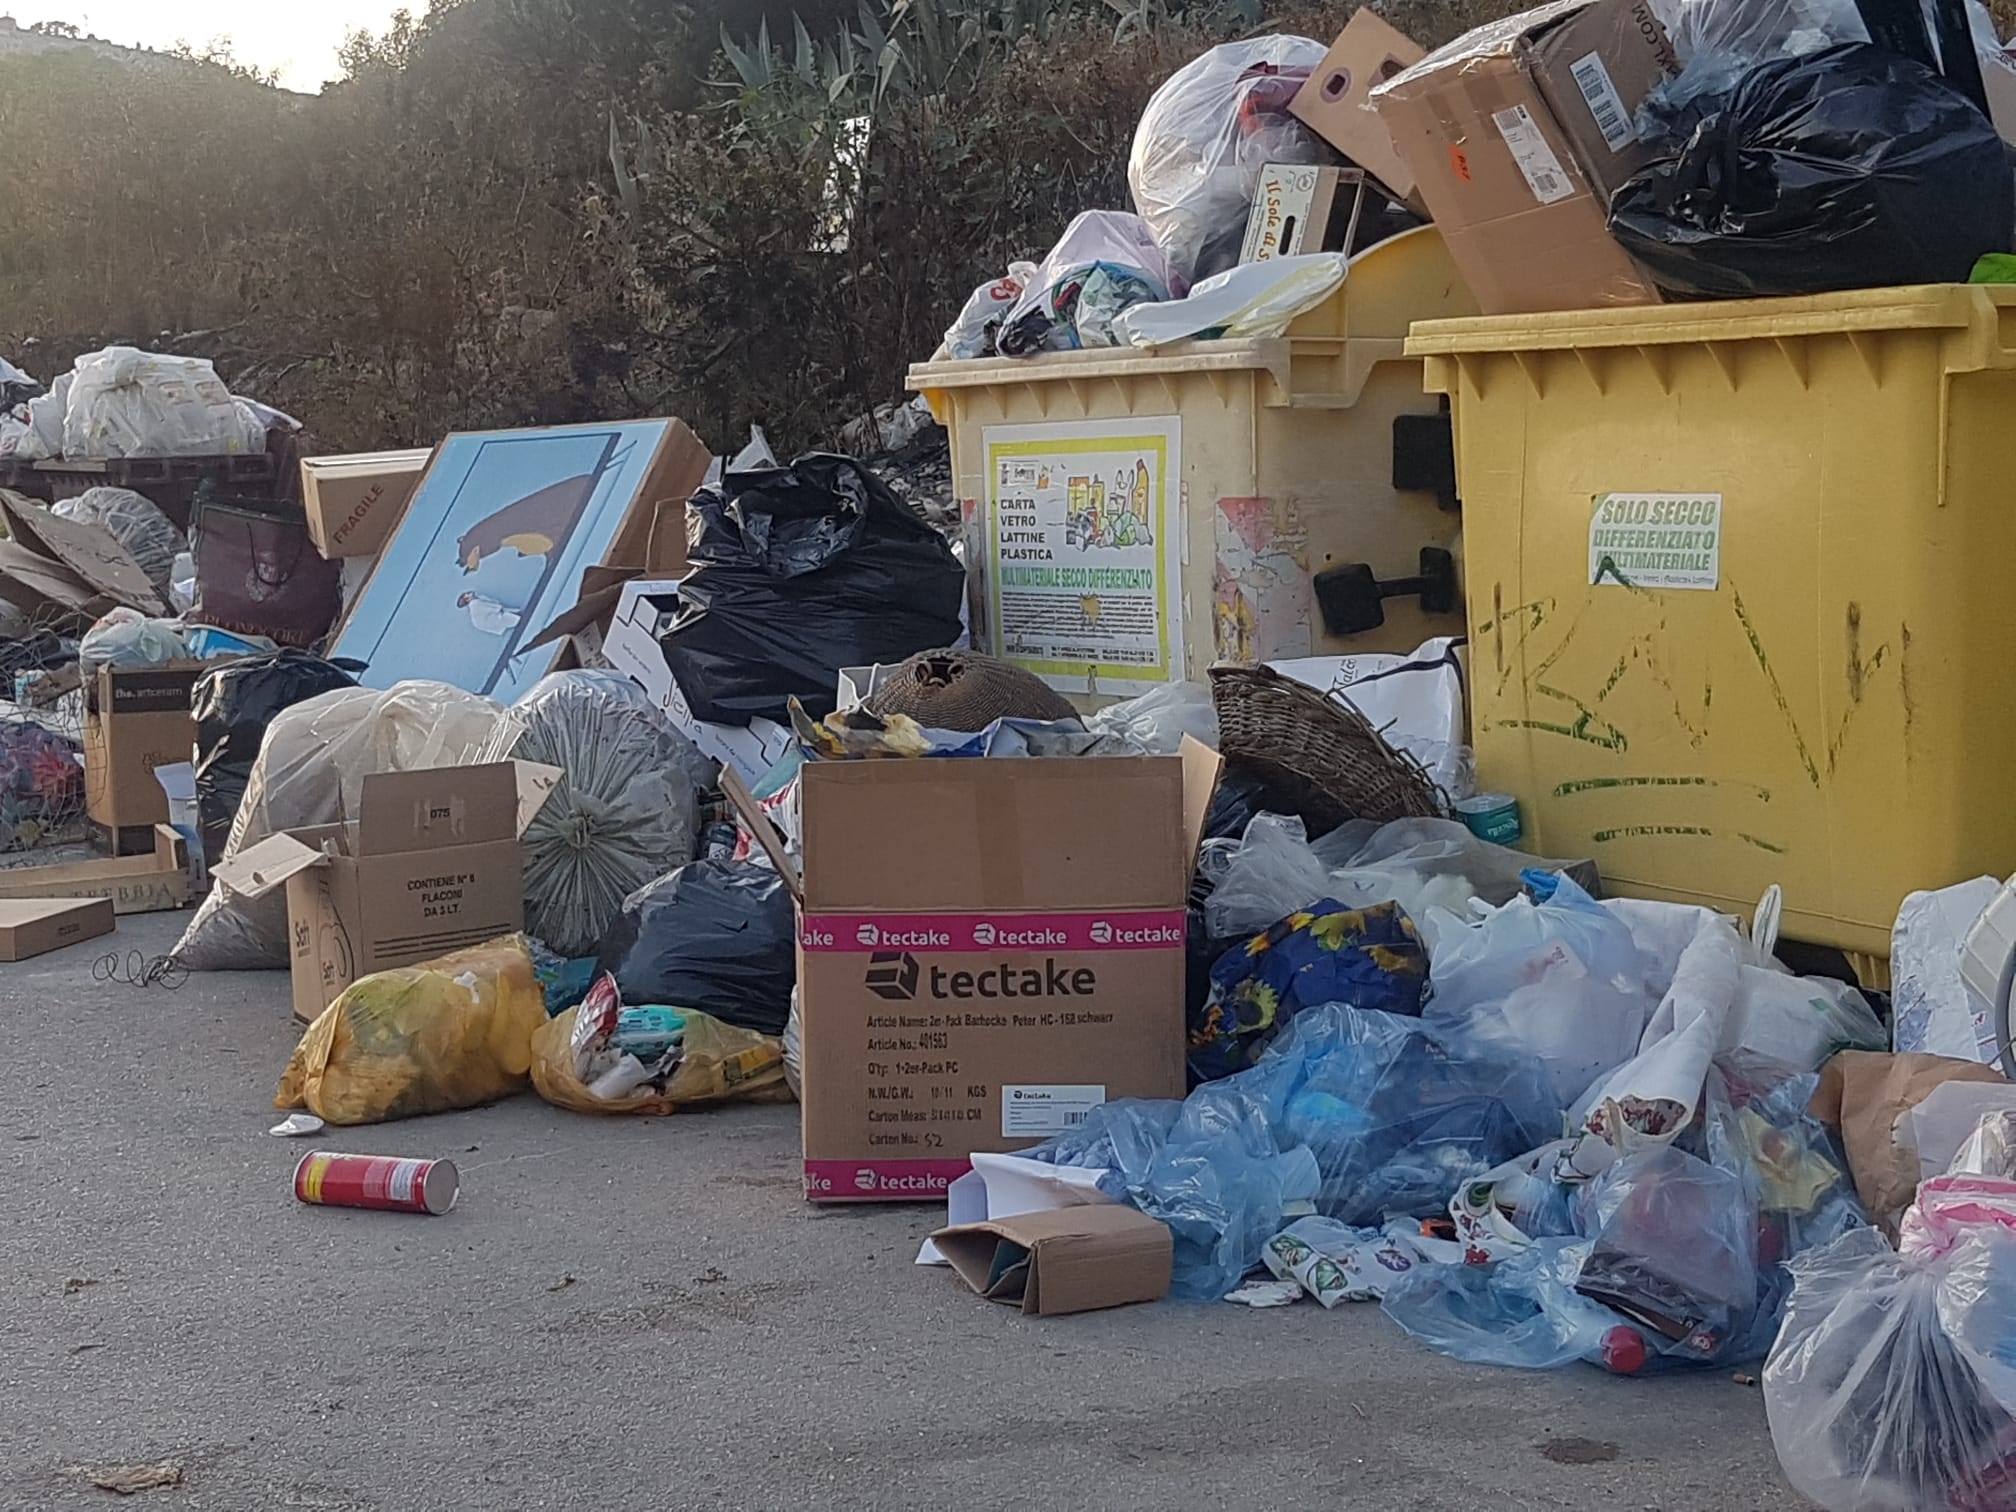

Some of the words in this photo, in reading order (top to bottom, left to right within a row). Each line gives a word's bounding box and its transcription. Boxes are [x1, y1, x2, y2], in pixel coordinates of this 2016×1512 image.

[1267, 197, 1281, 227] Sole
[1000, 499, 1036, 510] CARTA
[333, 482, 384, 544] FRAGILE
[1601, 500, 1649, 524] SOLO
[1649, 500, 1716, 525] SECCO
[1000, 515, 1036, 527] VETRO
[1000, 532, 1045, 543] LATTINE
[1593, 529, 1715, 550] DIFFERENZIATO
[1000, 549, 1053, 560] PLASTICA
[1061, 567, 1087, 588] SECCO
[407, 875, 455, 890] CONTIENE
[421, 890, 463, 903] FLACONI
[424, 907, 437, 917] DA
[802, 931, 833, 946] ake
[882, 931, 950, 946] tectake
[999, 929, 1067, 945] tectake
[1115, 927, 1180, 943] tectake
[930, 958, 1096, 999] tectake
[867, 1015, 897, 1028] Article
[1013, 1014, 1036, 1027] Peter
[867, 1039, 897, 1051] Article
[967, 1084, 987, 1098] KGS
[868, 1110, 899, 1123] Carton
[869, 1133, 900, 1146] Carton
[880, 1173, 948, 1190] tectake
